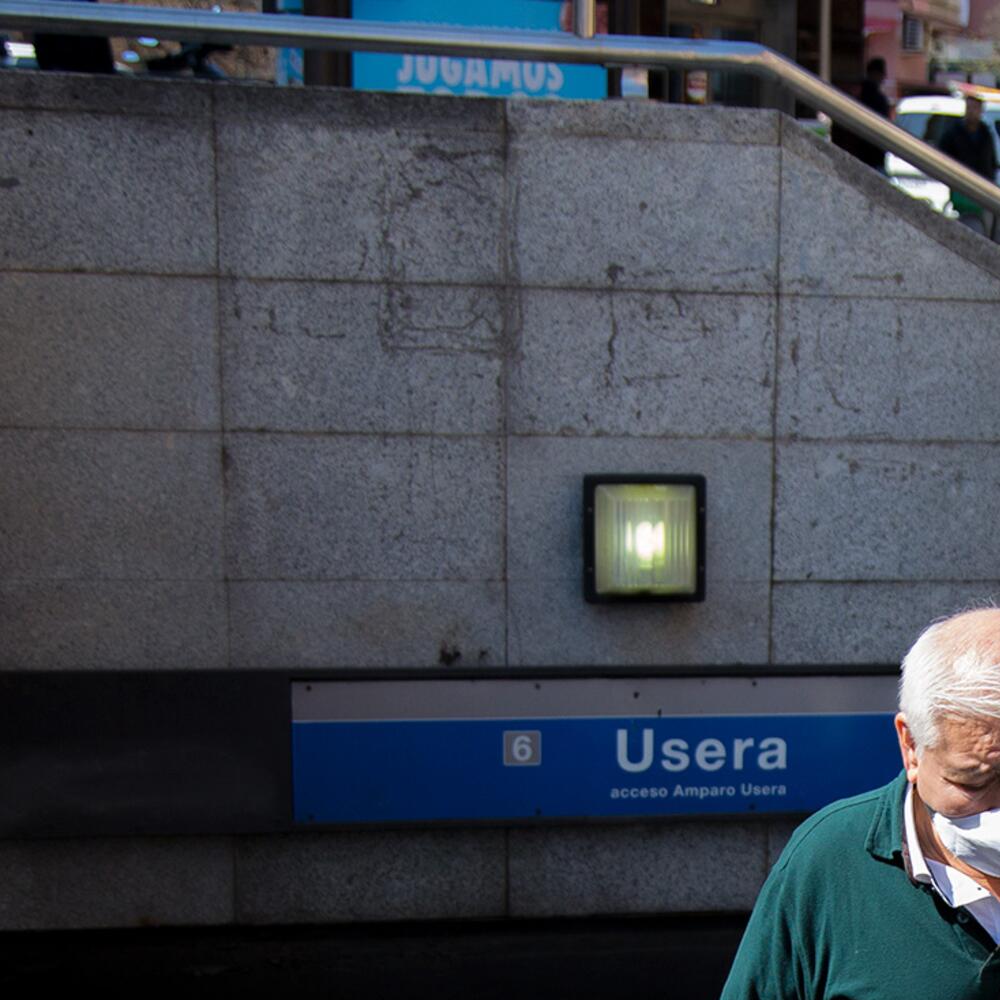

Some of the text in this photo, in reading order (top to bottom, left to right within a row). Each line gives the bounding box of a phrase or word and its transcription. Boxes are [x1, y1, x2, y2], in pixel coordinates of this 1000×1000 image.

[511, 734, 533, 763] 6
[616, 728, 788, 773] Usera
[610, 783, 787, 799] acceso Amparo Usera
